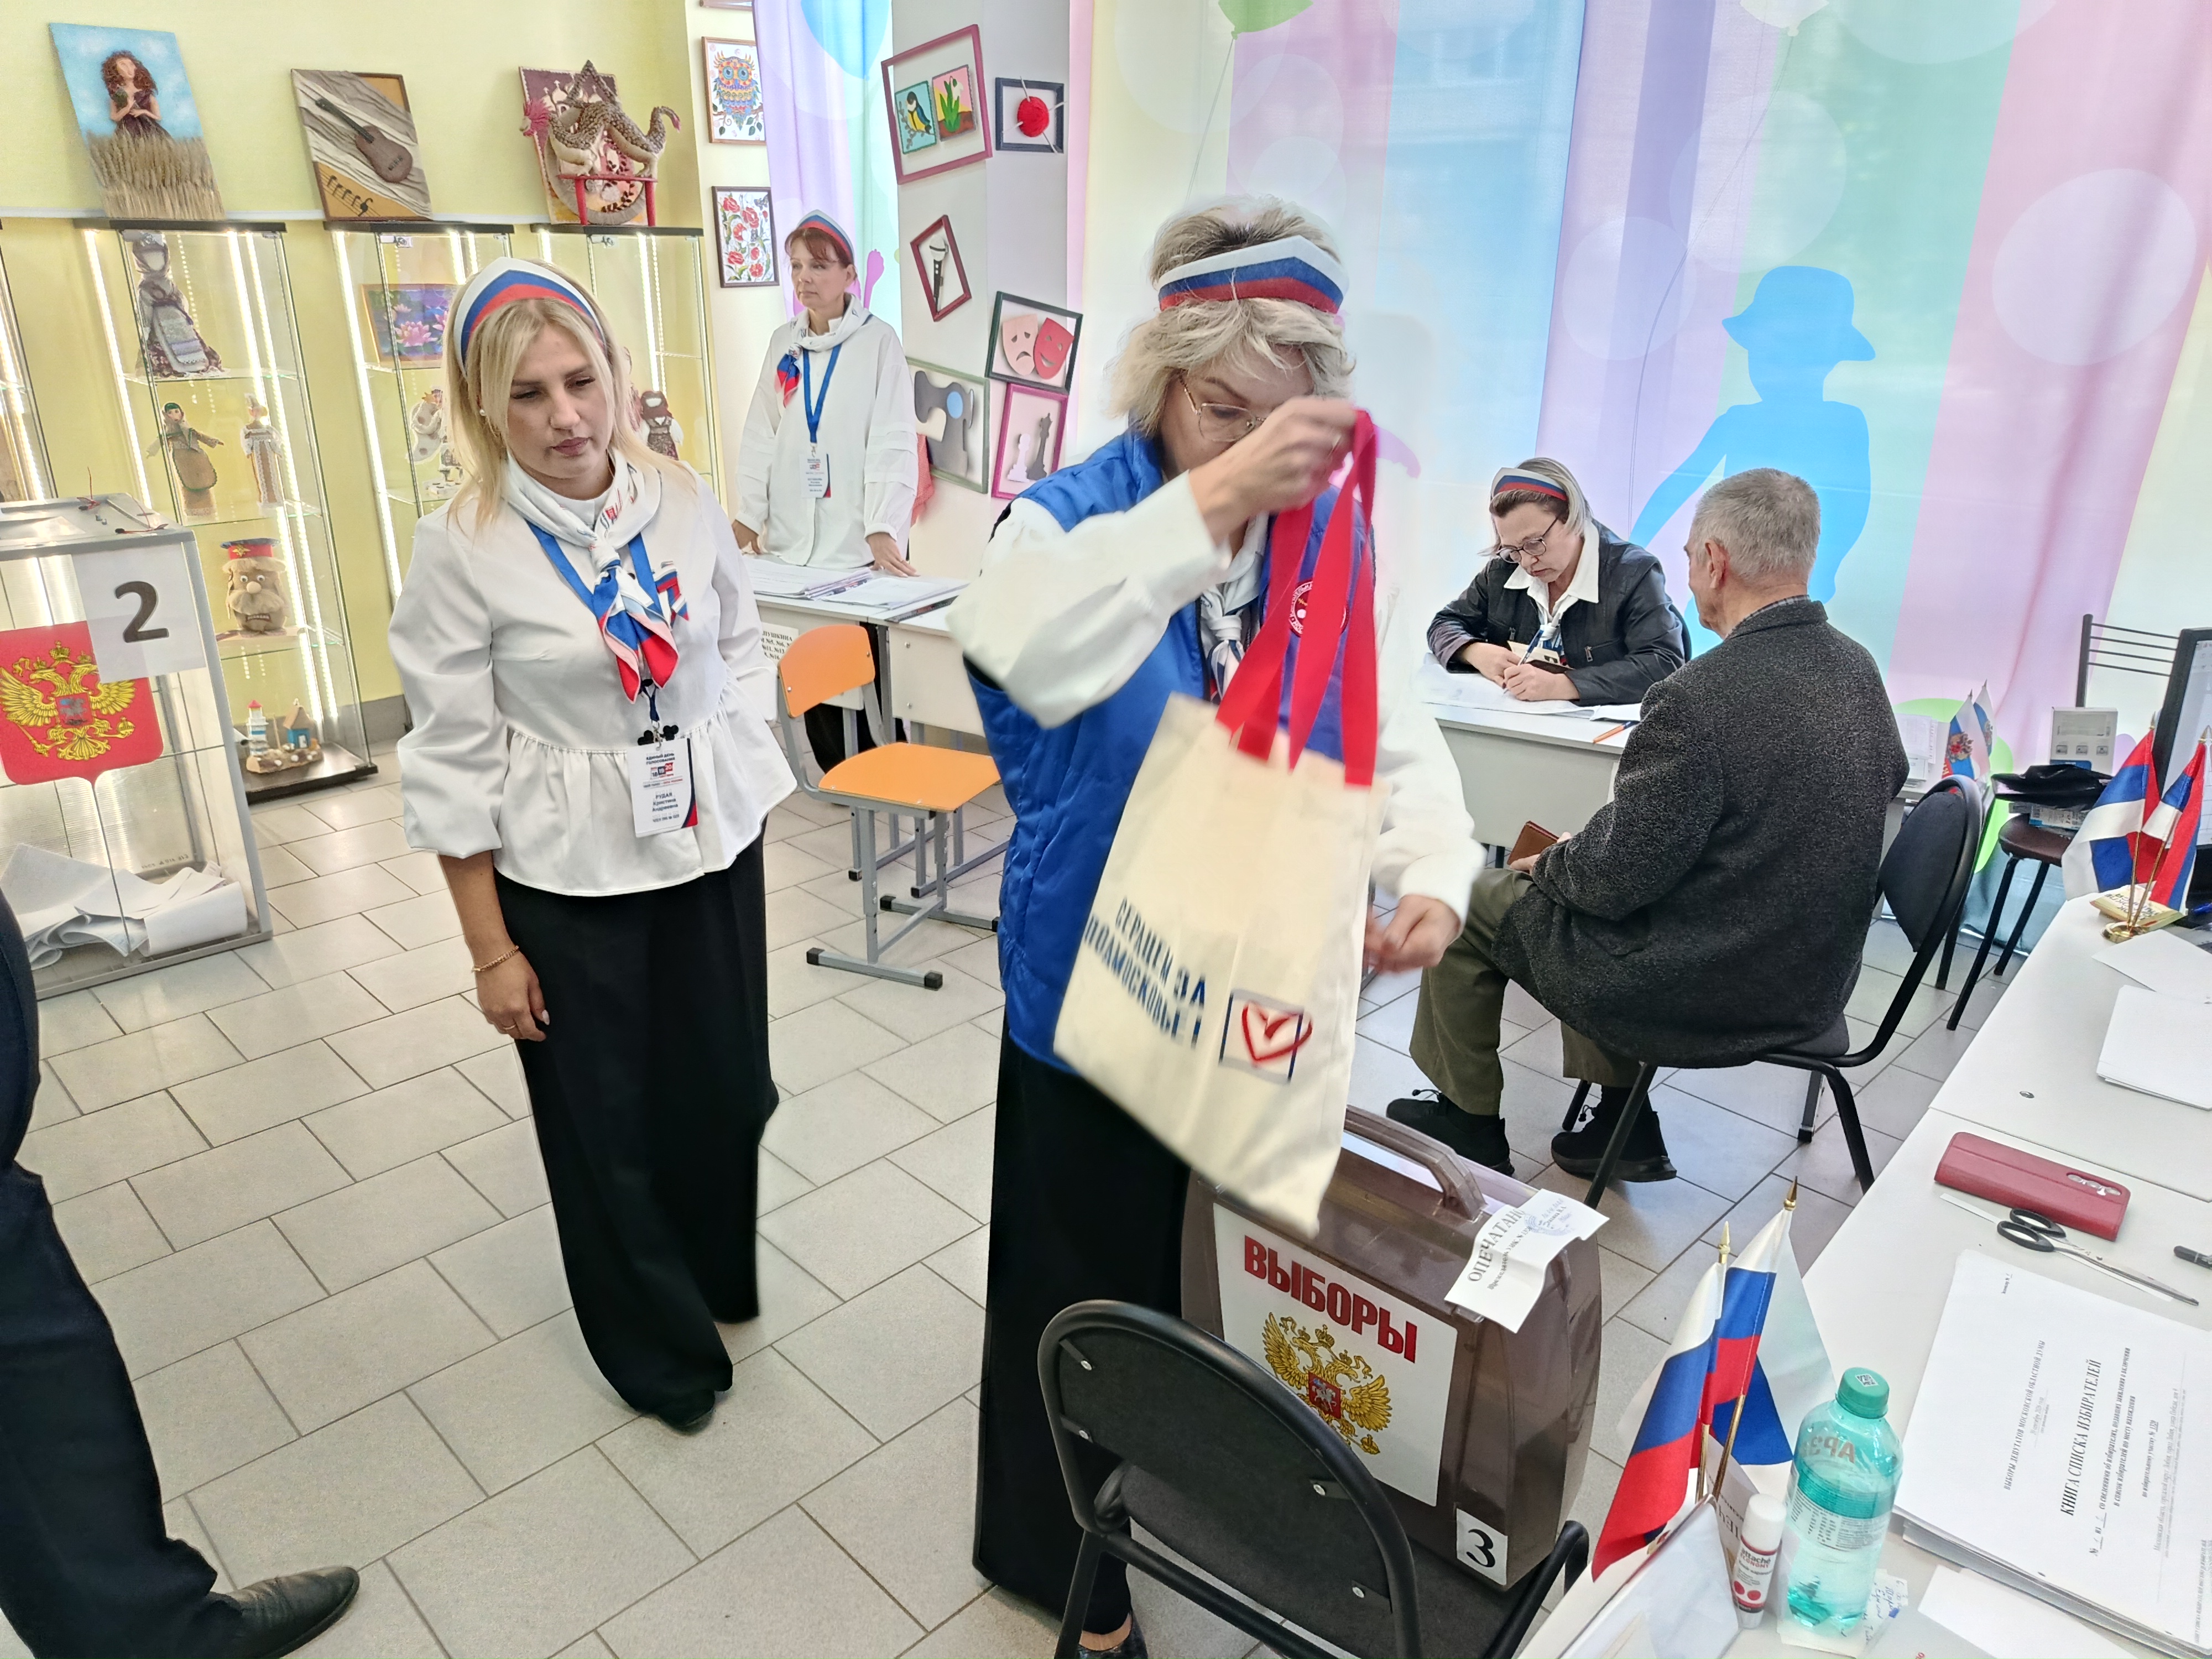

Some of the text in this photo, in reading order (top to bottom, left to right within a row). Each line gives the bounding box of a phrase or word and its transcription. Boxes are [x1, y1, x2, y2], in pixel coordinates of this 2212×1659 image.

[114, 581, 169, 643] 2
[1467, 1207, 1526, 1282] ОПЕЧАТАНО
[1244, 1234, 1418, 1364] ВЫБОРЫ
[2004, 1339, 2045, 1490] ВЫБОРЫ ДЕПУТАТОВ МОСКОВСКОЙ ОБЛАСТНОЙ ДУМЫ
[2059, 1359, 2101, 1516] КНИГА СПИСКА ИЗБИРАТЕЛЕЙ
[2114, 1481, 2122, 1501] список
[2117, 1448, 2131, 1482] избирателей
[1466, 1528, 1496, 1568] 3
